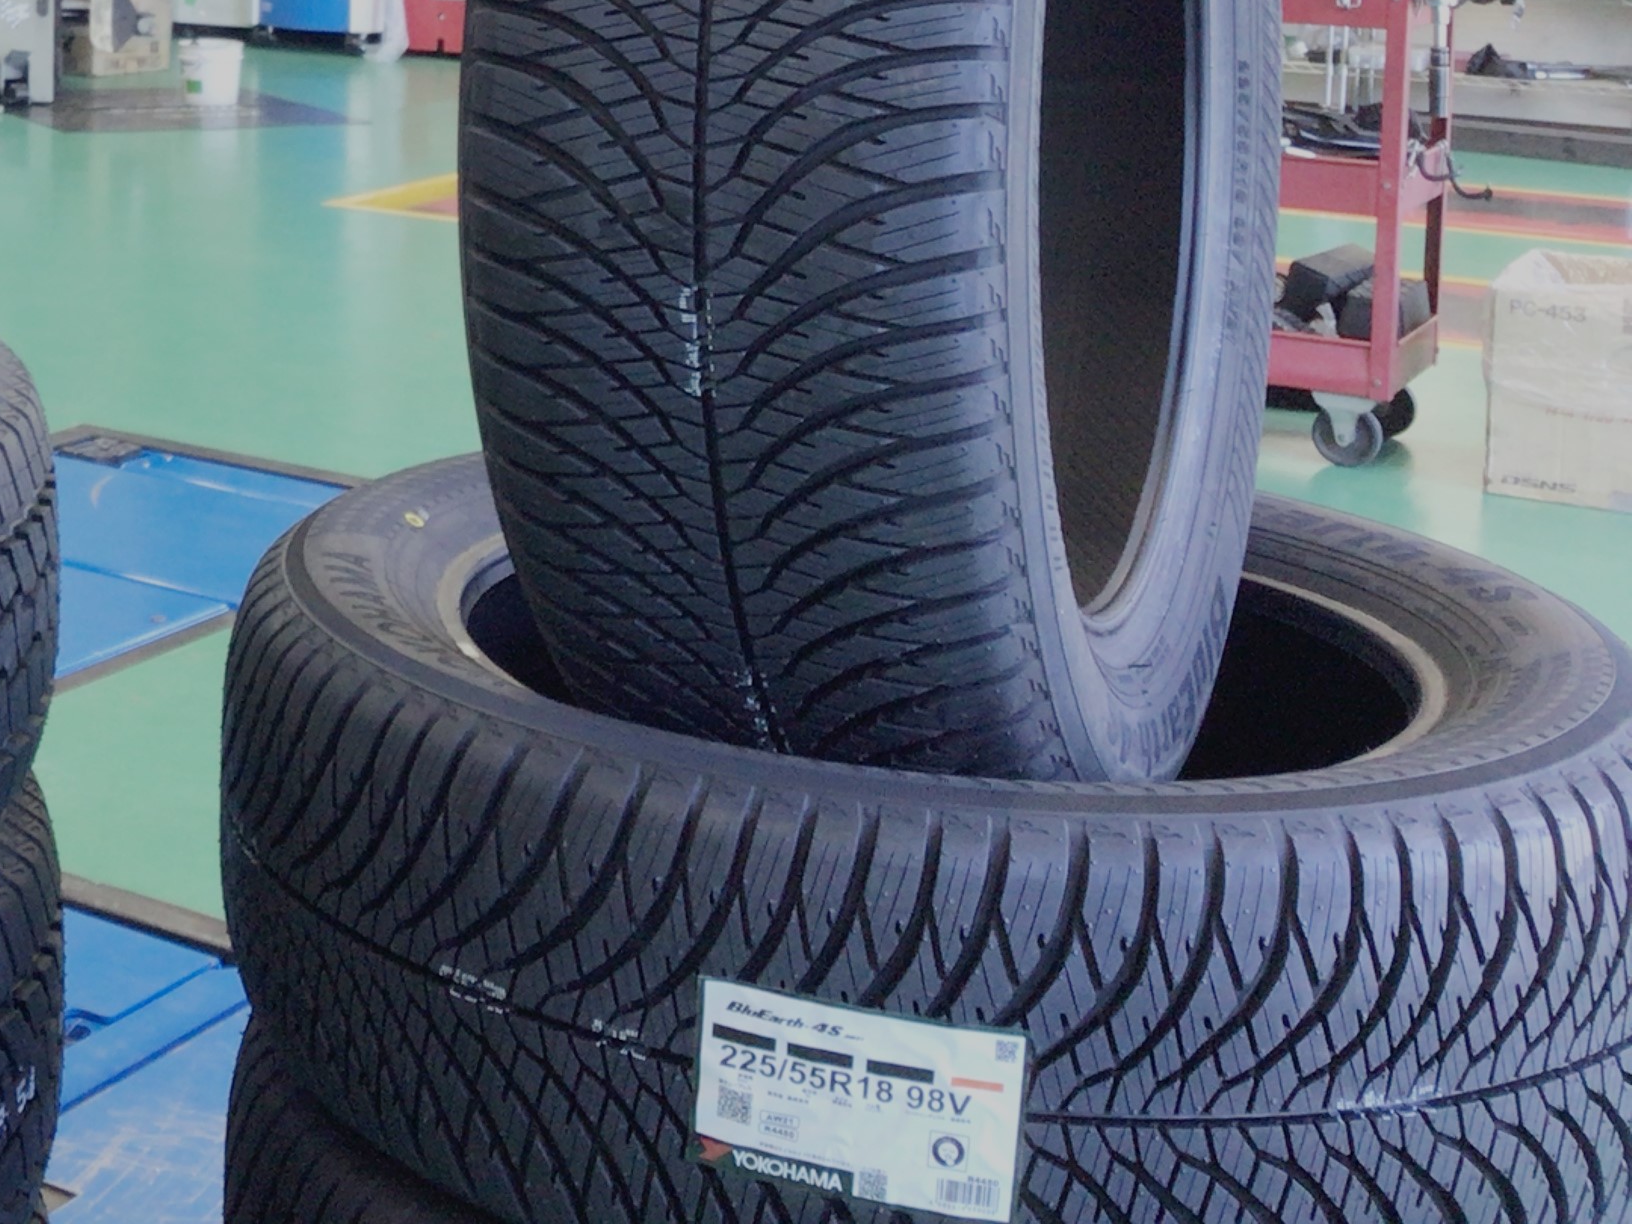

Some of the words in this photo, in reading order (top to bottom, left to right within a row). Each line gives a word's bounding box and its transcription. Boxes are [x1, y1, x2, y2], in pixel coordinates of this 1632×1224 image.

[719, 1043, 894, 1103] 225/55R18
[906, 1085, 972, 1116] 98V
[731, 1148, 843, 1193] YOKOHAMA
